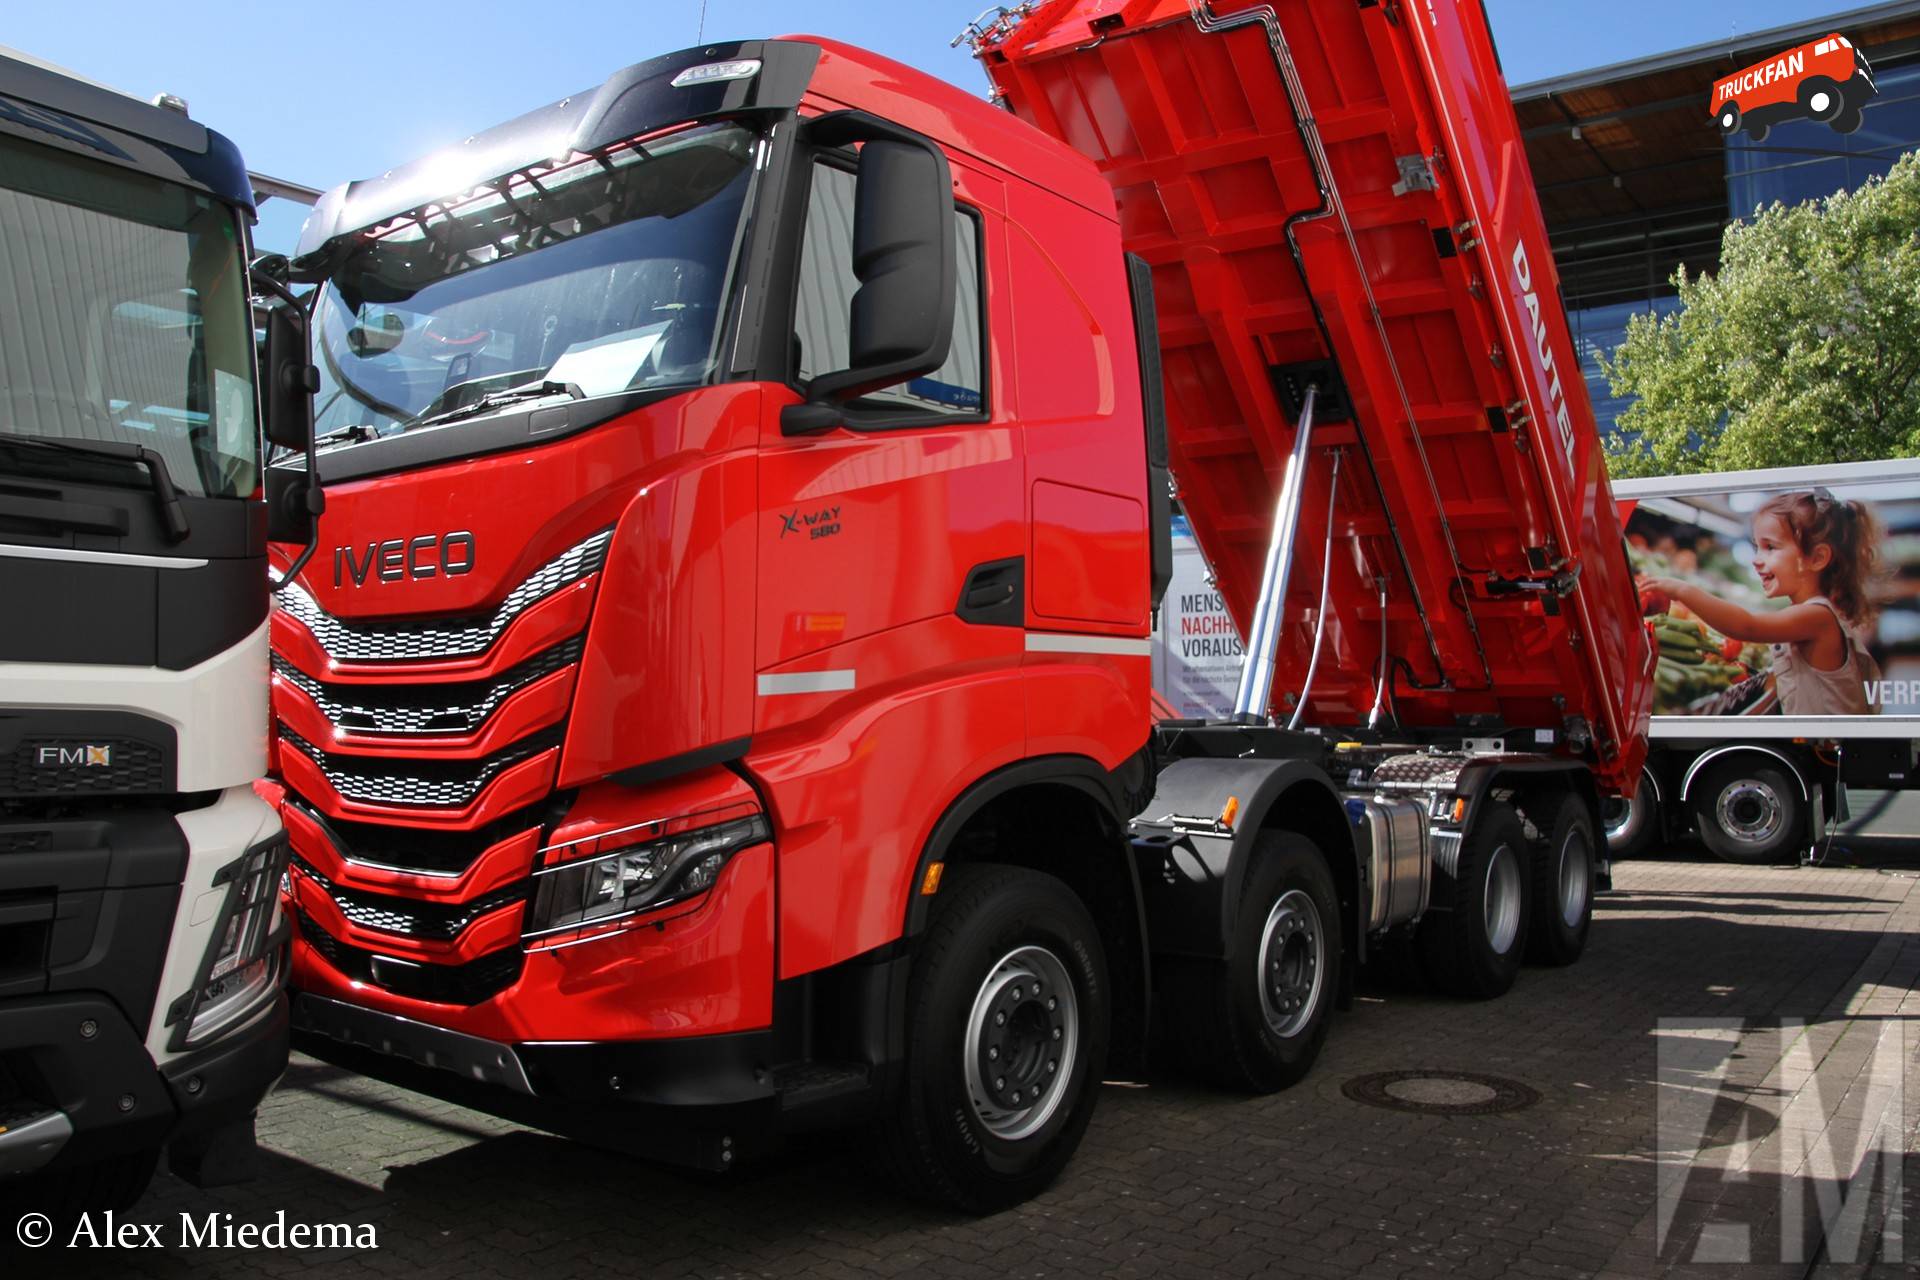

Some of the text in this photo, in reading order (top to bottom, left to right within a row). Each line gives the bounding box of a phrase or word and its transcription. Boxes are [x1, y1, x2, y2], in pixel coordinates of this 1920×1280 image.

[1512, 239, 1576, 481] DAUTEL
[779, 506, 841, 539] X-WAY
[334, 530, 475, 589] IVECO
[1181, 638, 1242, 657] VORAUS
[38, 745, 110, 766] FMX
